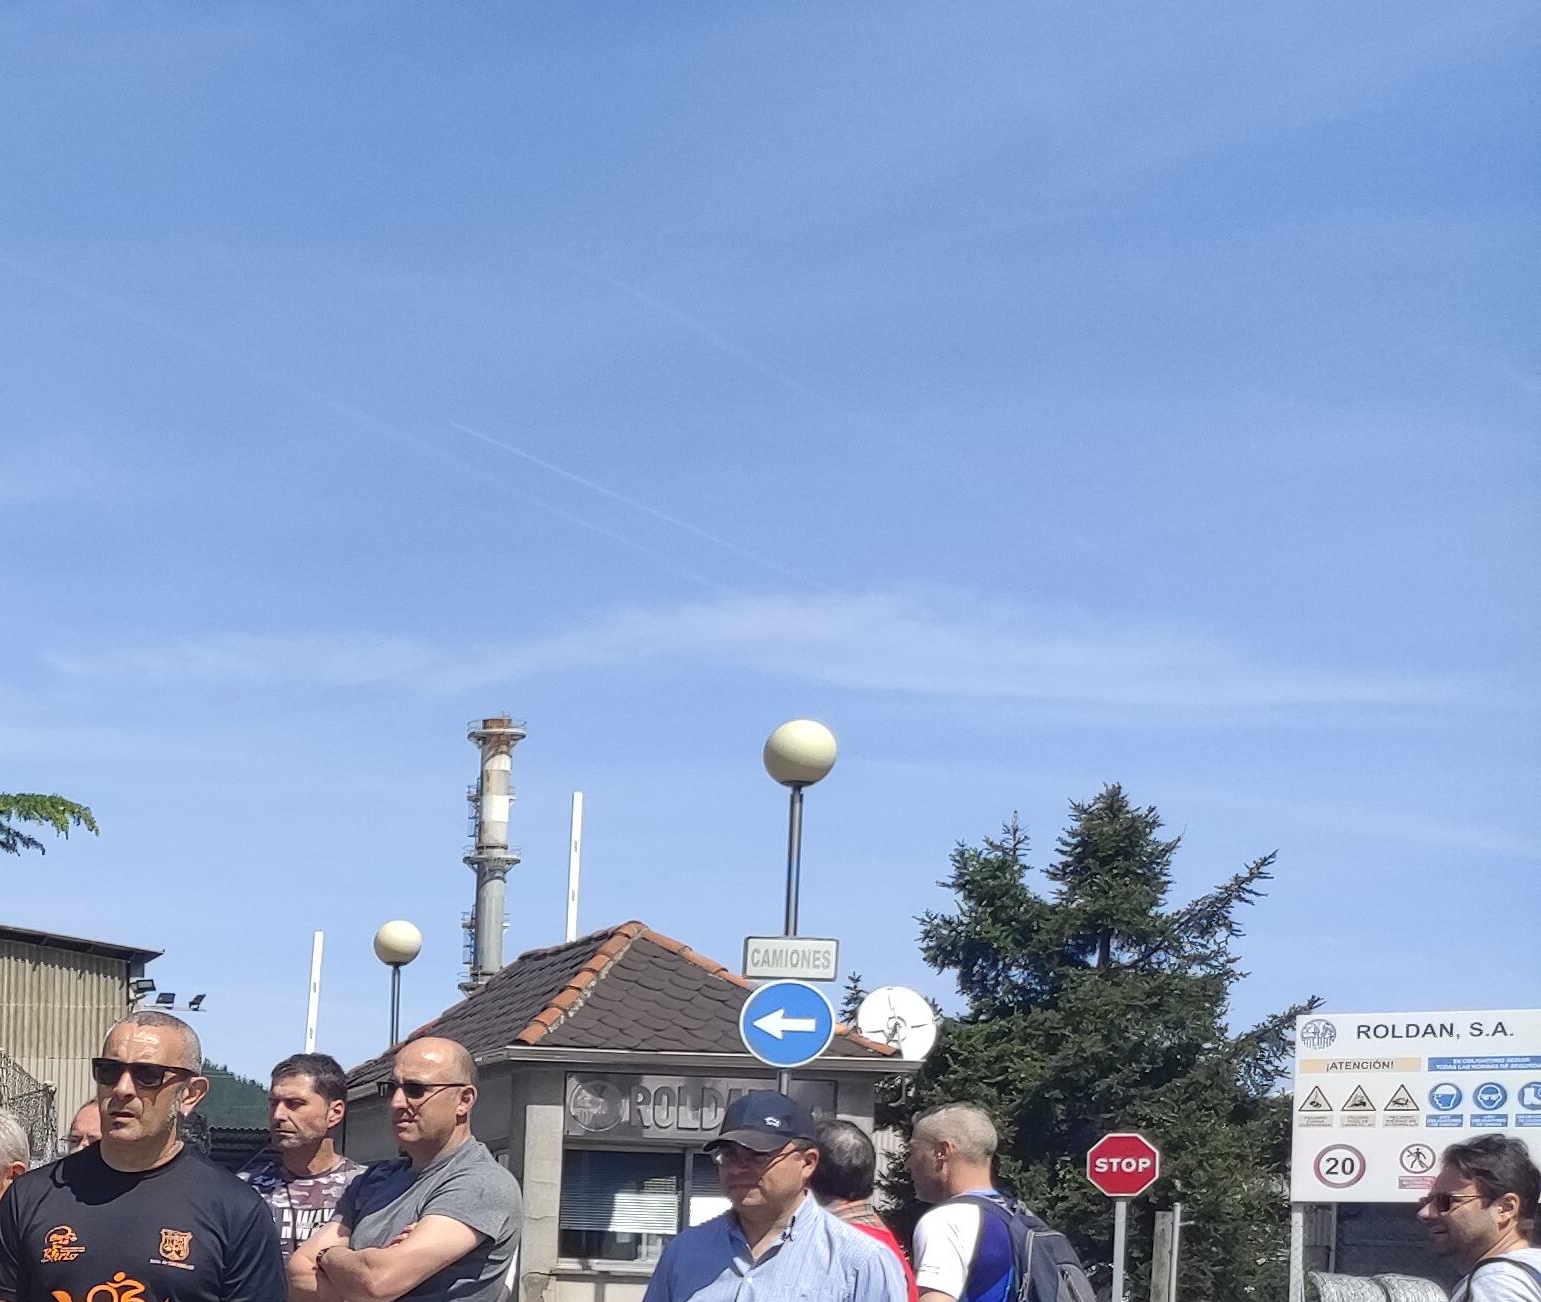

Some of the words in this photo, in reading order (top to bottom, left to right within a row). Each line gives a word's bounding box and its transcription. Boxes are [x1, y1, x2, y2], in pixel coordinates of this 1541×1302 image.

[751, 948, 831, 970] CAMIONES
[1357, 1023, 1460, 1040] ROLDAN,
[1469, 1022, 1514, 1038] S.A.
[1326, 1060, 1394, 1072] ¡ATENCIÓN!
[1095, 1158, 1151, 1173] STOP
[1325, 1157, 1355, 1176] 20
